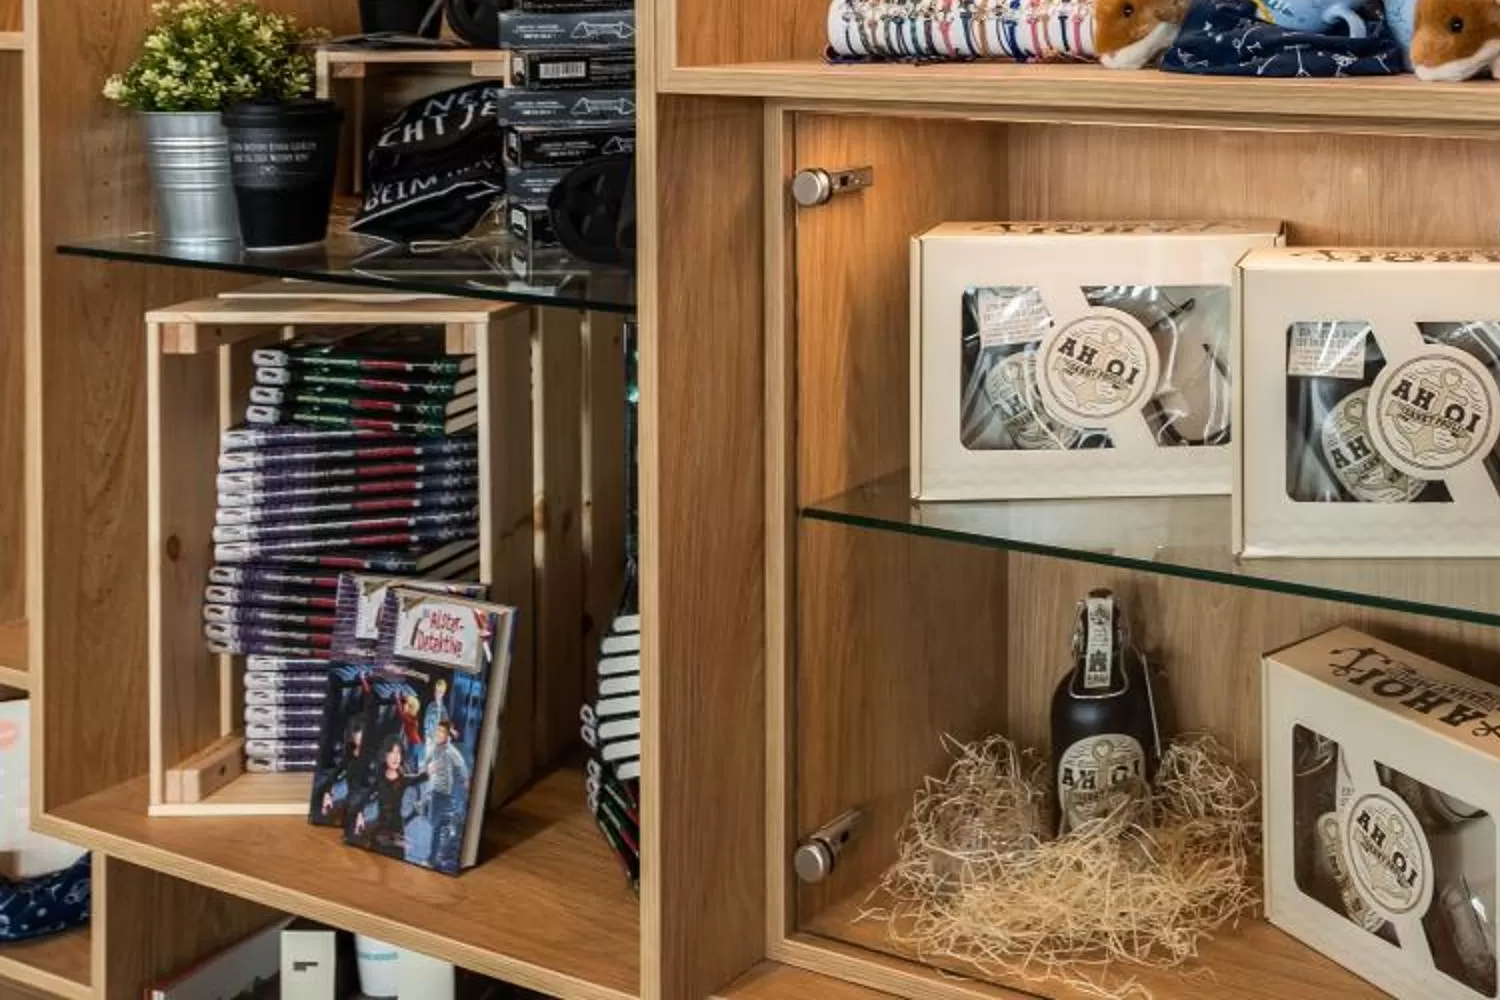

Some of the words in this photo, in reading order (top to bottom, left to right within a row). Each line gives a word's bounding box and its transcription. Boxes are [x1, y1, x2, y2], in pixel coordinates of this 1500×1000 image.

[1058, 337, 1140, 387] AHOI
[1391, 379, 1482, 434] AHOI
[1348, 667, 1487, 727] AHOI
